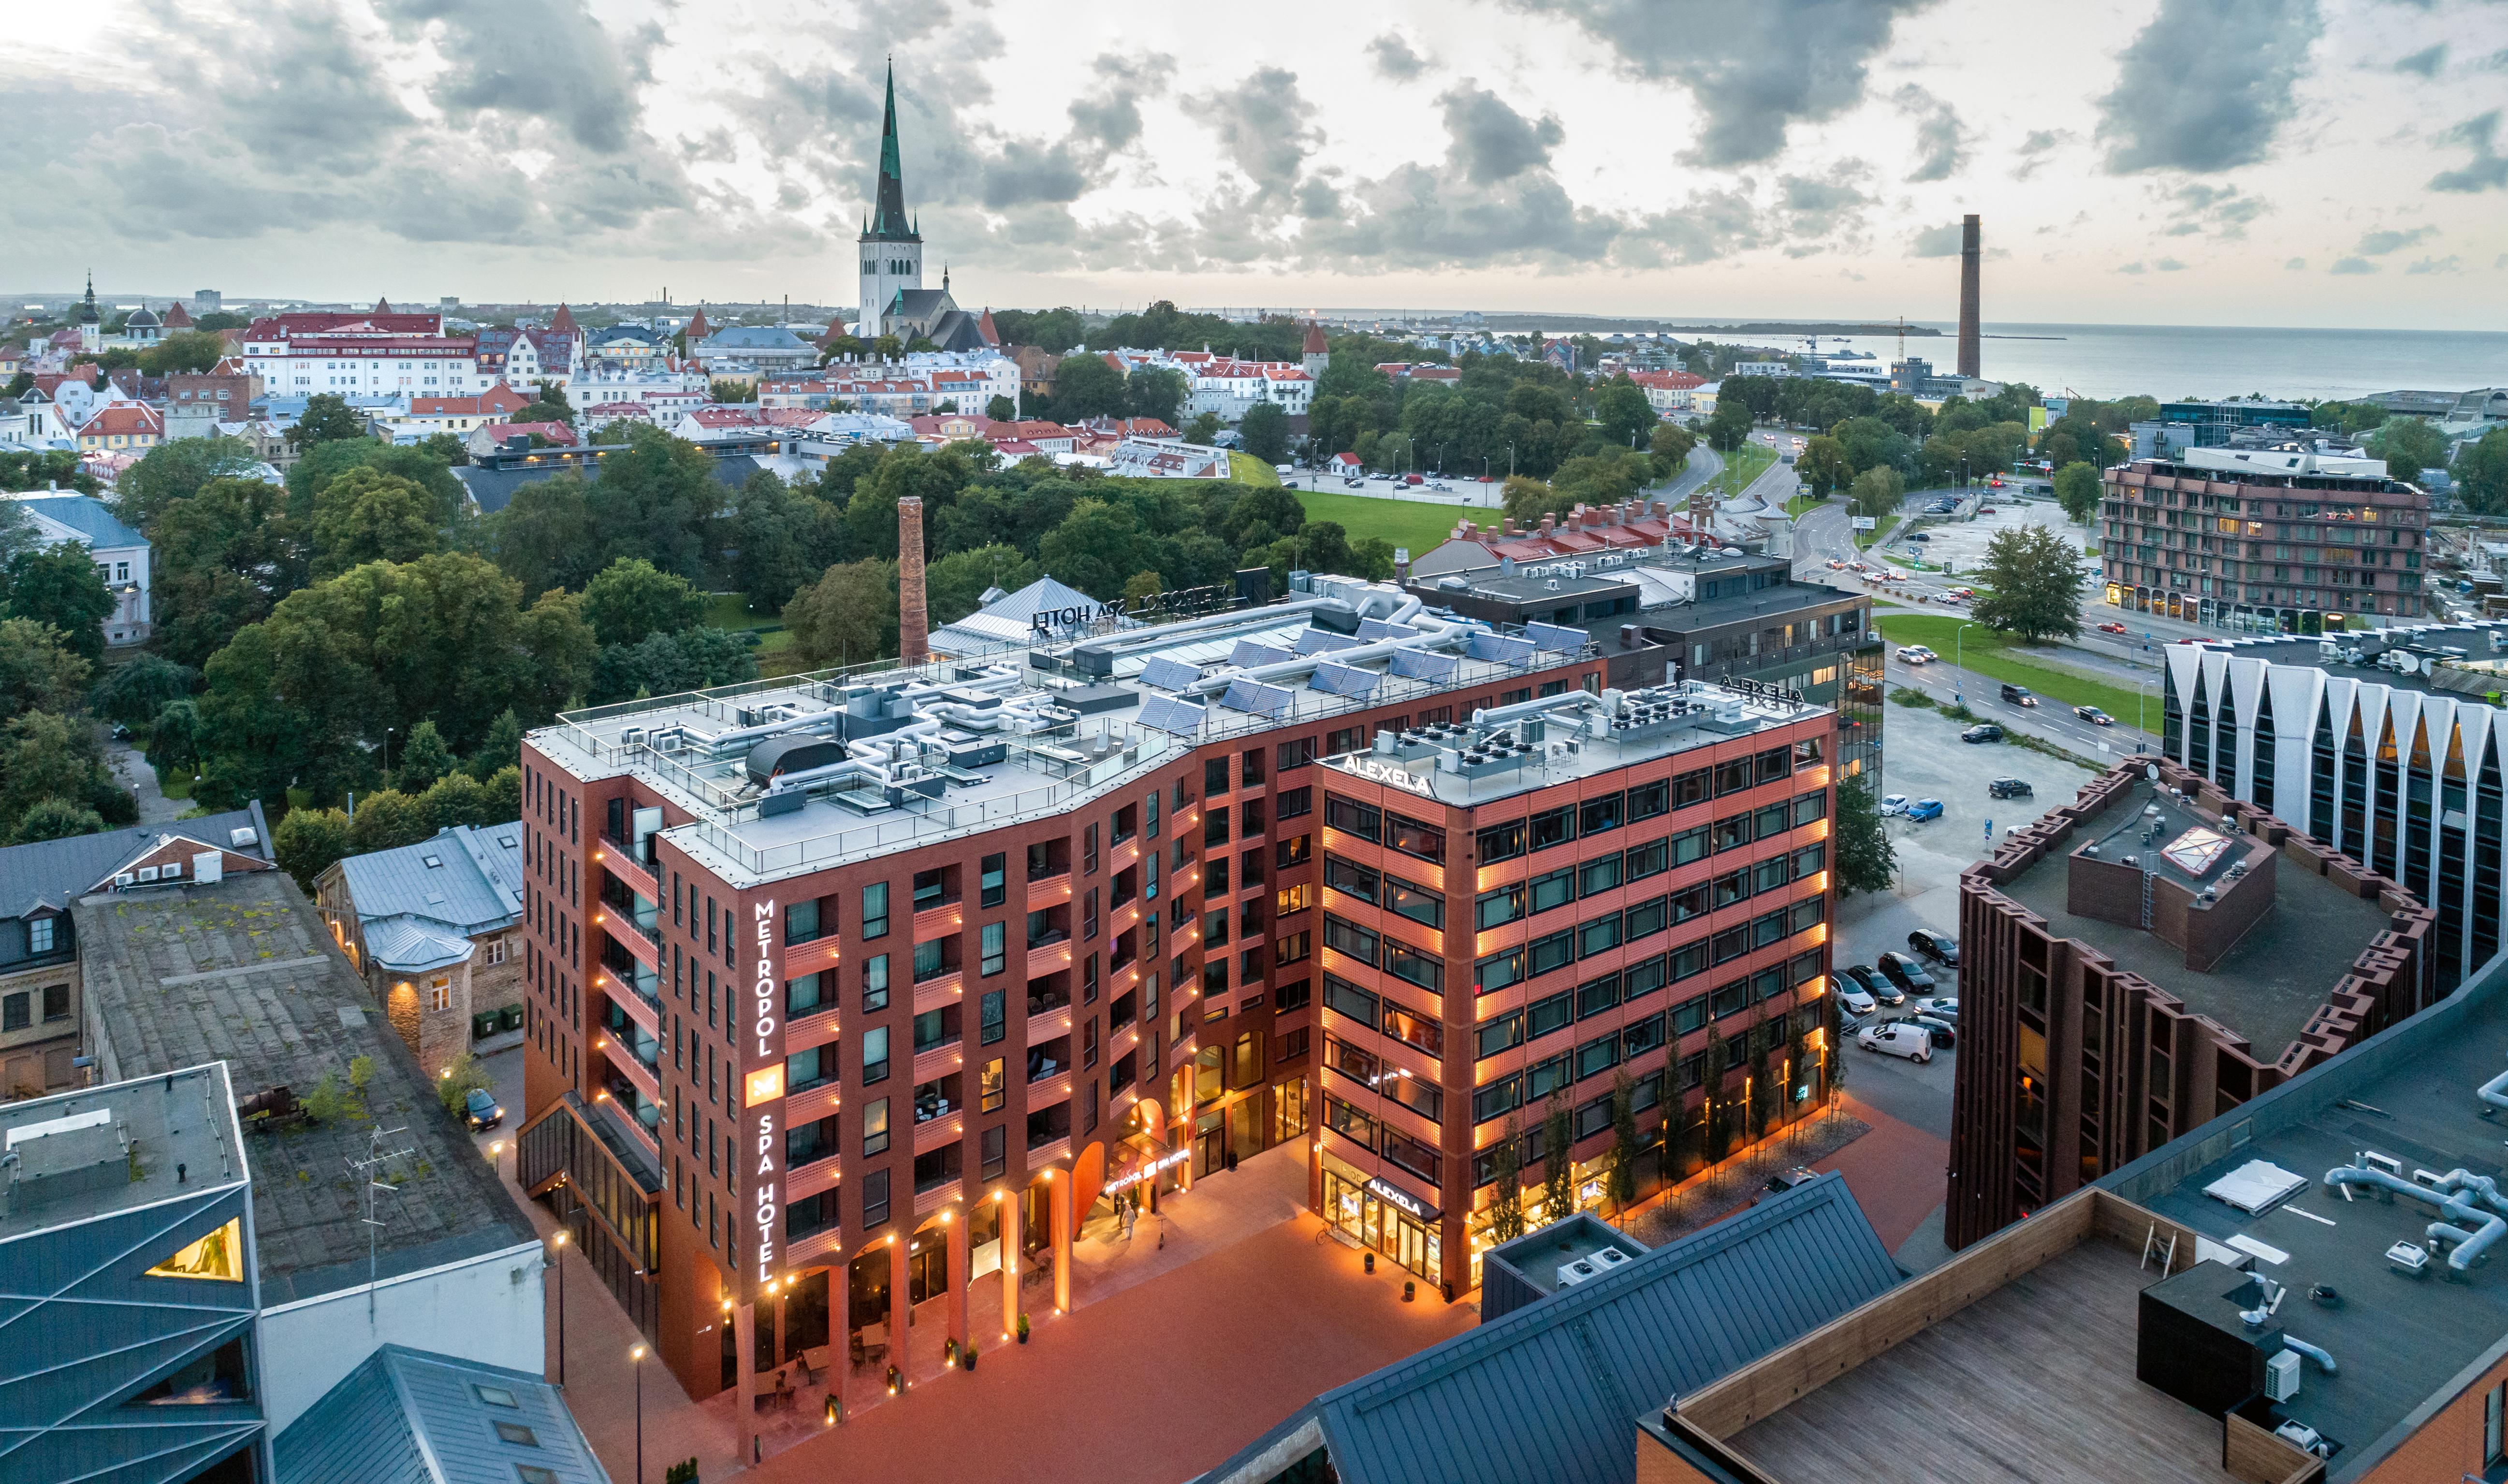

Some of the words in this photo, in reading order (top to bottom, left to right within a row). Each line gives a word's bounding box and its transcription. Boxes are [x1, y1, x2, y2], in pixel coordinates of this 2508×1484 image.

[1343, 755, 1430, 796] ALEXELA
[756, 899, 774, 1057] METROPOL
[758, 1115, 773, 1175] SPA
[1105, 1171, 1142, 1194] METROPOL
[1157, 1157, 1170, 1170] SPA
[1170, 1148, 1190, 1164] HOTEL
[1369, 1179, 1421, 1216] ALEXELA
[757, 1183, 775, 1283] HOTEL
